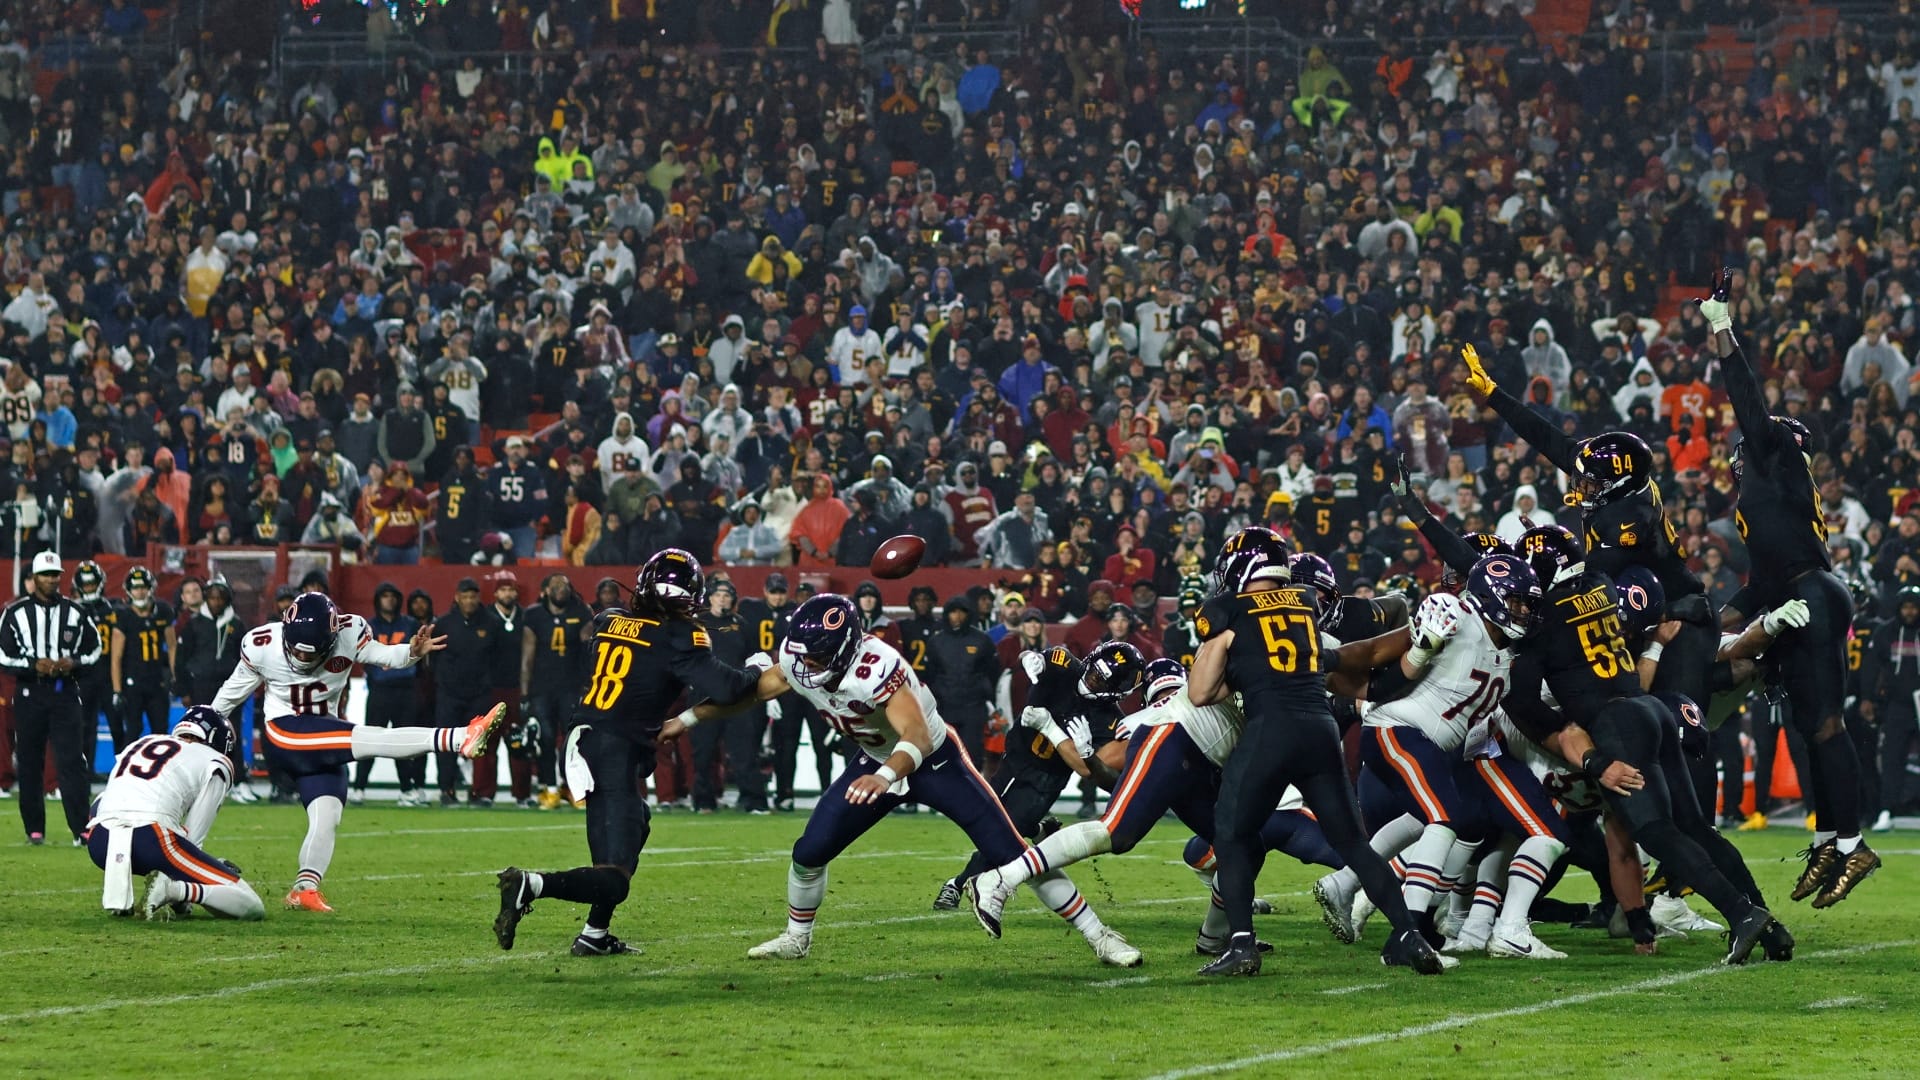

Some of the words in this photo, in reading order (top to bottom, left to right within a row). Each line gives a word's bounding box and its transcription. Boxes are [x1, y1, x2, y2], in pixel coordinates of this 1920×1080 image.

[1293, 318, 1307, 344] 9
[552, 347, 567, 366] 17
[852, 349, 864, 371] 5
[3, 396, 31, 424] 89
[435, 416, 447, 440] 5
[228, 441, 245, 464] 18
[1612, 454, 1633, 474] 94
[500, 476, 526, 502] 55
[447, 494, 461, 519] 5
[1316, 508, 1331, 536] 5
[1226, 532, 1246, 553] 57
[1478, 534, 1498, 547] 96
[1525, 534, 1544, 555] 55
[1252, 591, 1304, 608] BELLORE
[1572, 591, 1611, 614] MARTIN
[252, 629, 272, 647] 16
[607, 617, 643, 638] OWENS
[759, 619, 775, 651] 6
[139, 630, 159, 662] 11
[551, 626, 567, 657] 4
[1258, 614, 1319, 673] 57
[1577, 613, 1636, 679] 55
[855, 651, 881, 680] 85
[910, 640, 926, 671] 2
[583, 642, 633, 710] 18
[290, 681, 329, 717] 16
[1441, 668, 1505, 729] 70
[115, 738, 182, 781] 19
